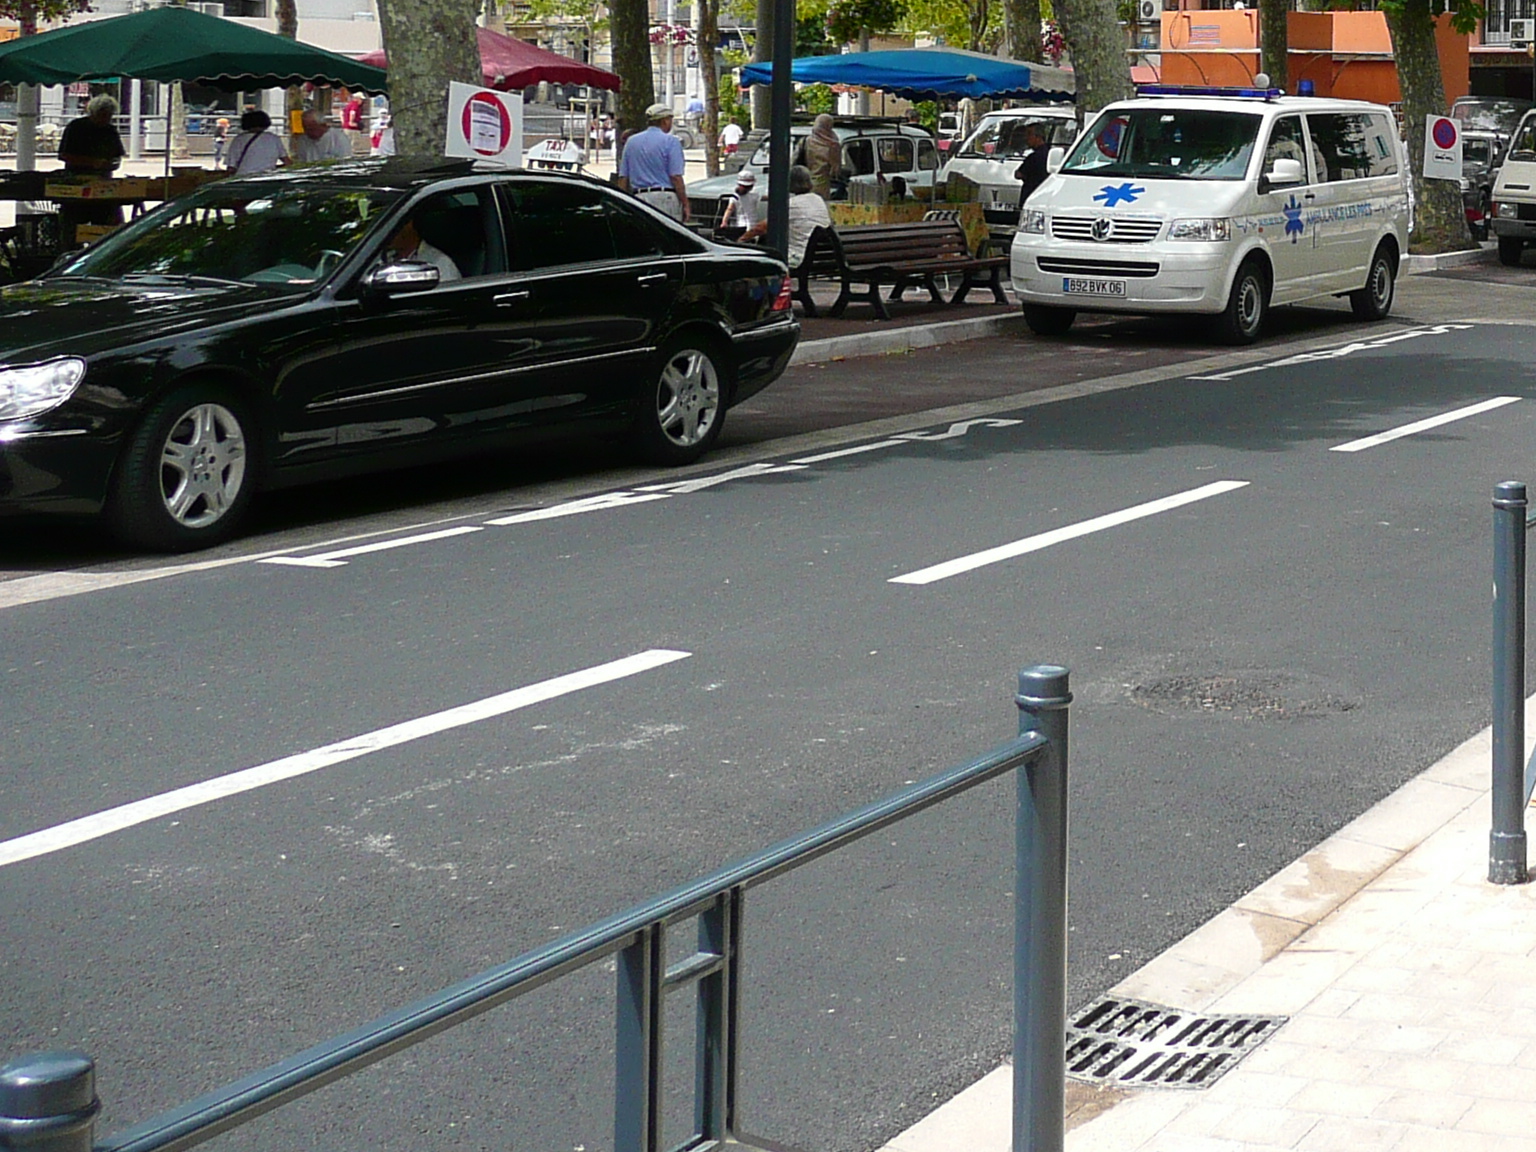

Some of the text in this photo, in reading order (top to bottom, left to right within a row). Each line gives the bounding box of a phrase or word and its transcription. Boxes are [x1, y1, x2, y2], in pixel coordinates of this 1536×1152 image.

[545, 140, 568, 152] TAXI
[1089, 281, 1107, 293] BVK
[1109, 282, 1122, 294] 06
